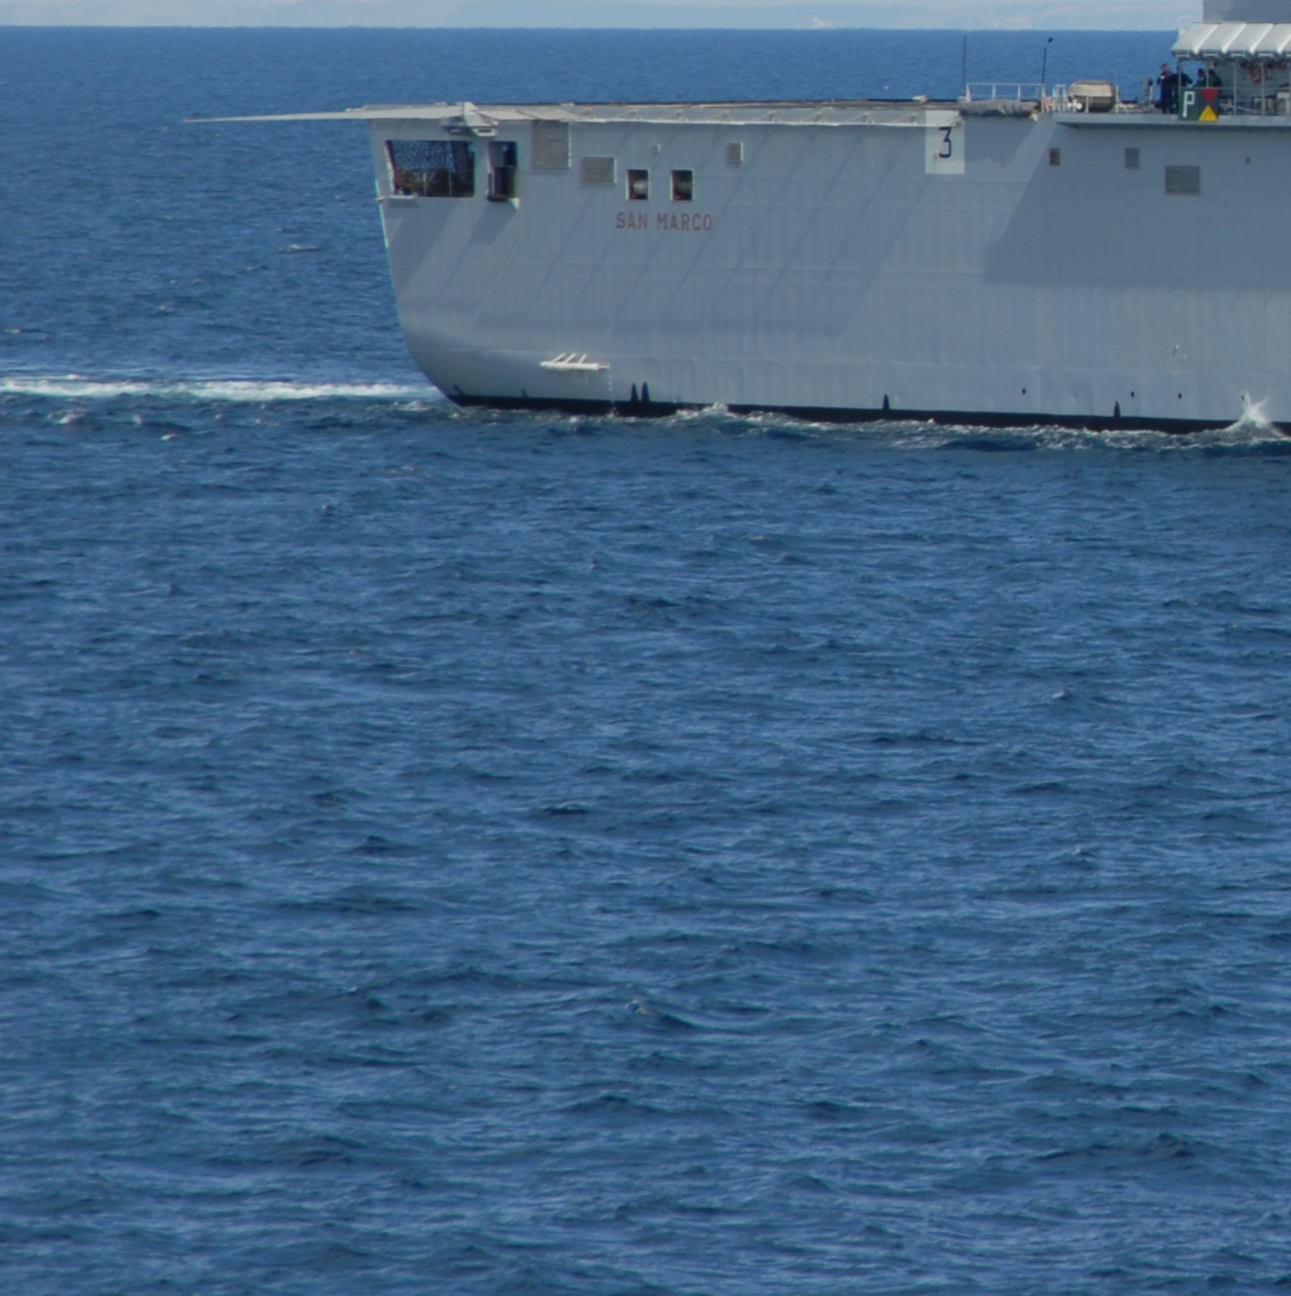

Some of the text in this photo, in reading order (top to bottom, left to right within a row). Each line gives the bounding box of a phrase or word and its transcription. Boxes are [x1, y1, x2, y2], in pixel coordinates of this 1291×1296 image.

[1183, 91, 1195, 118] P
[938, 127, 952, 159] 3
[616, 211, 713, 231] SAN MARCO
